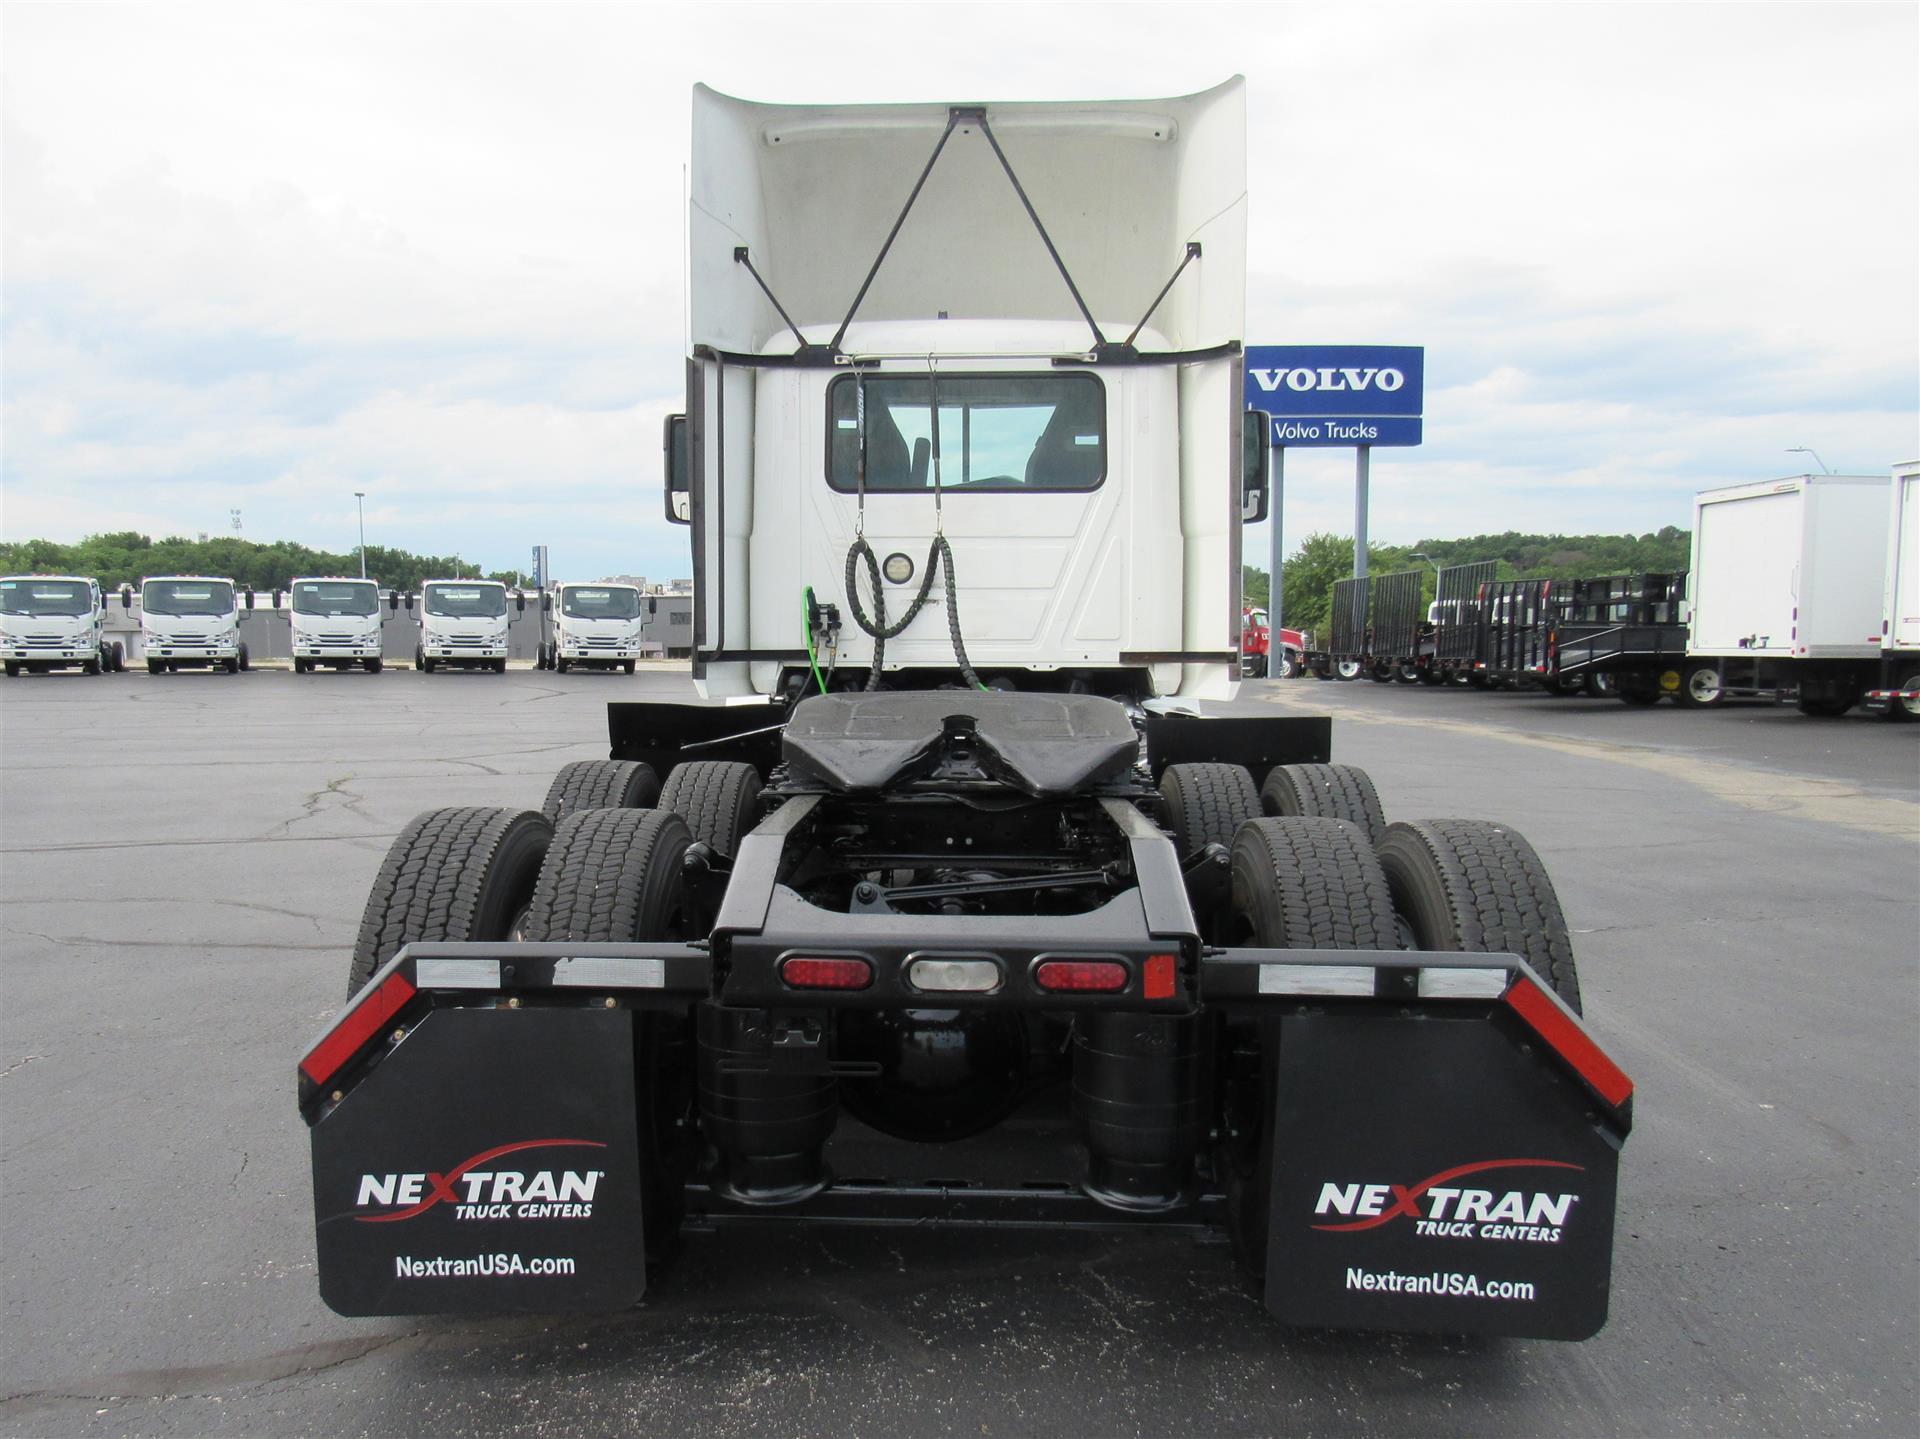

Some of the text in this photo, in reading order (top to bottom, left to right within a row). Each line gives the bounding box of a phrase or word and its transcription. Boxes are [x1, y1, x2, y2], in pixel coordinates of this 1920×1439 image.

[1249, 368, 1404, 391] VOLVO
[1275, 422, 1378, 439] Volvo Trucks
[356, 1170, 599, 1206] NEXTRAN
[455, 1203, 592, 1220] TRUCK CENTERS
[1314, 1182, 1572, 1226] NEXTRAN
[1415, 1220, 1561, 1242] TRUCK CENTERS
[396, 1253, 576, 1278] NextranUSA.com
[1346, 1267, 1534, 1300] NextranUSA.com
